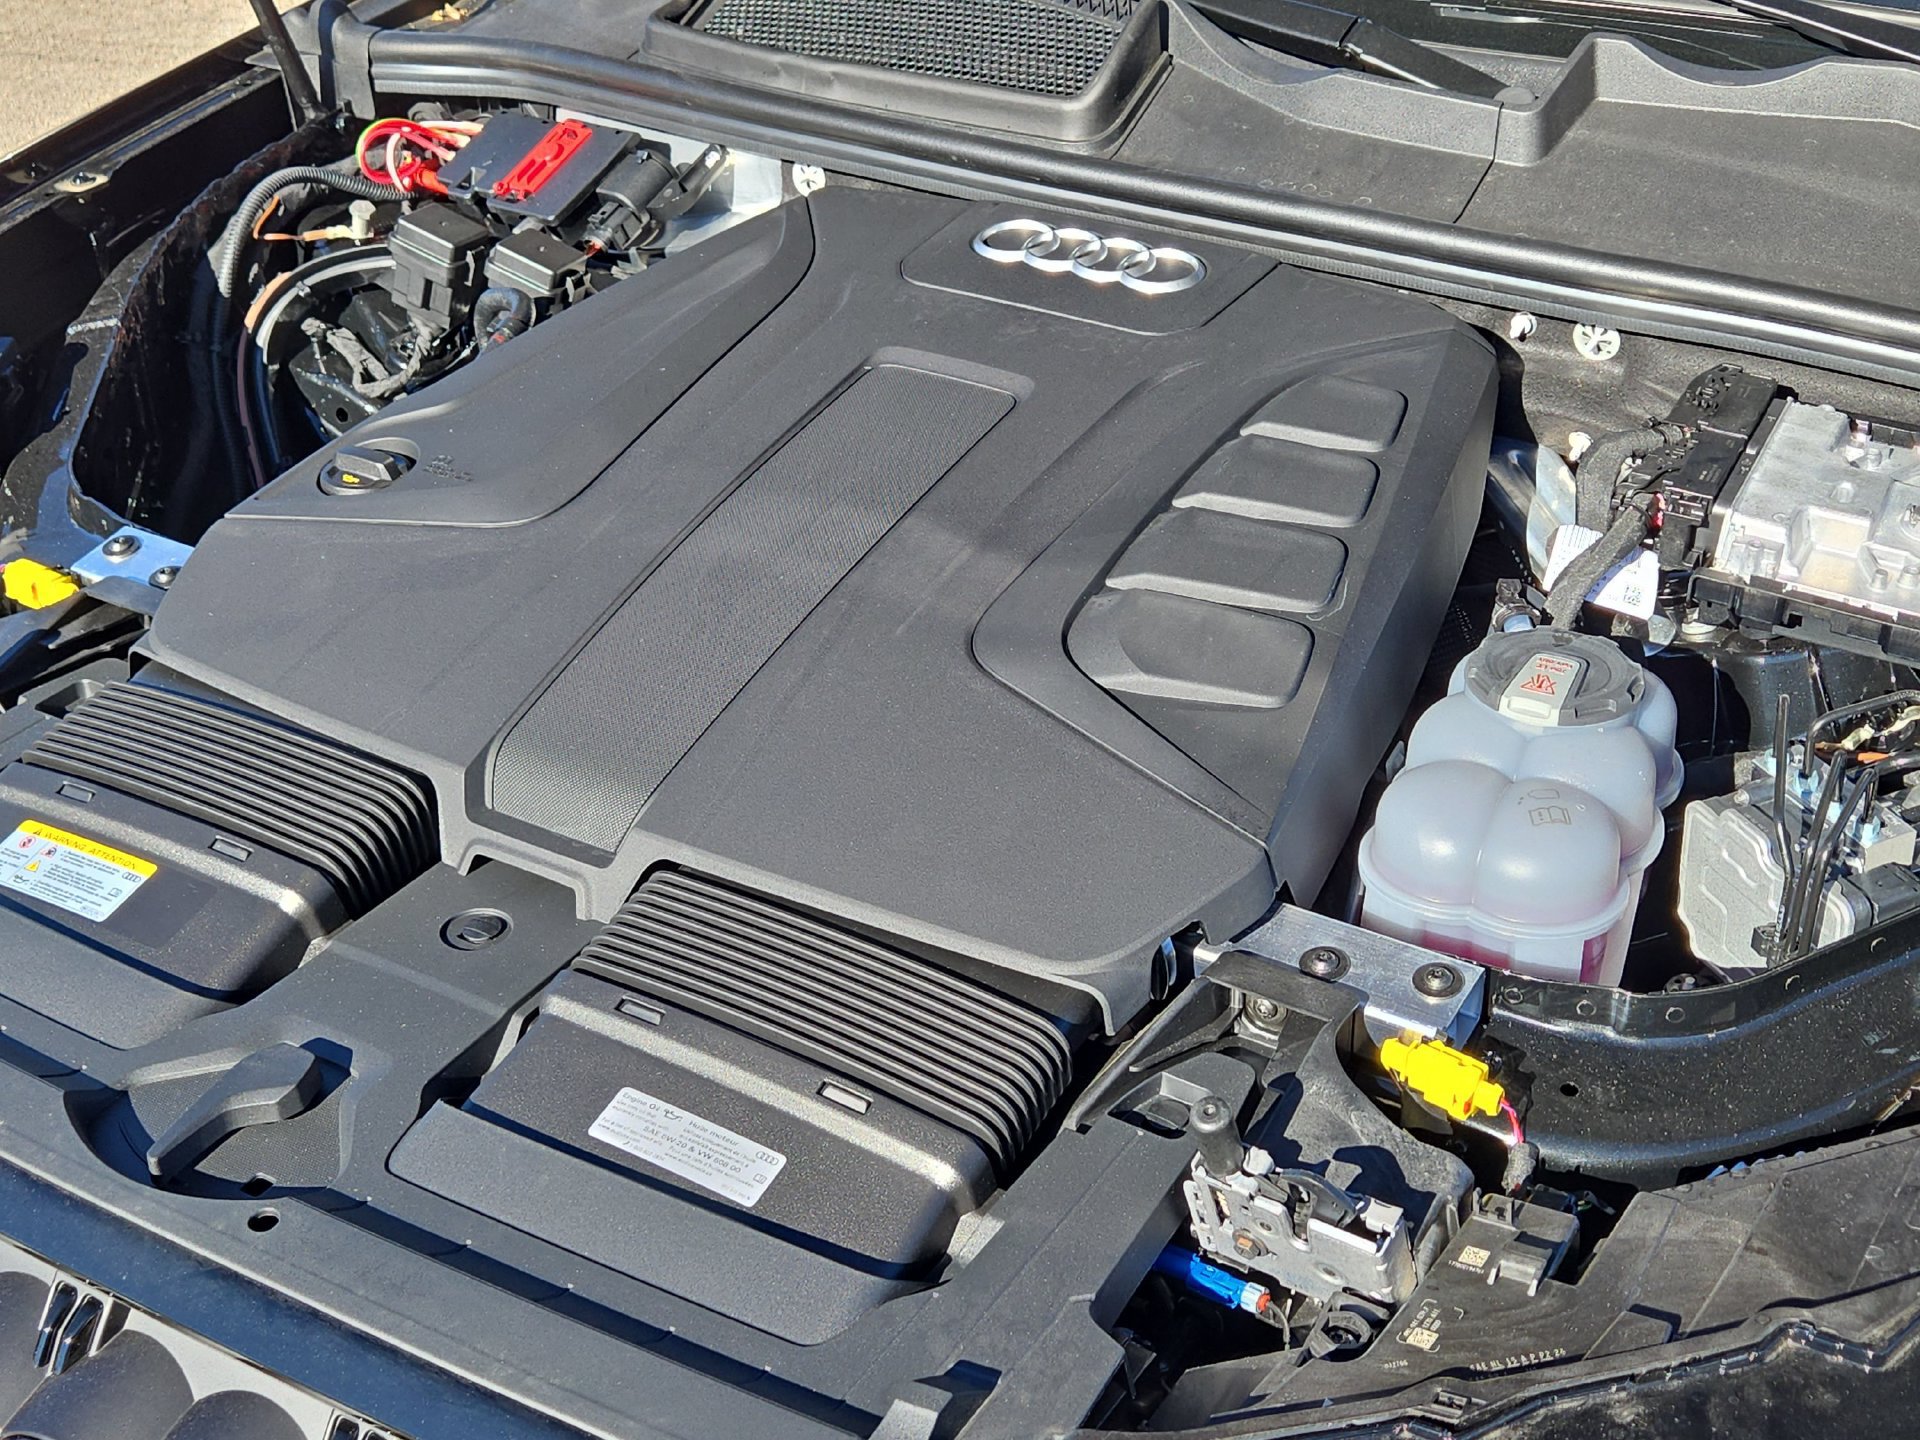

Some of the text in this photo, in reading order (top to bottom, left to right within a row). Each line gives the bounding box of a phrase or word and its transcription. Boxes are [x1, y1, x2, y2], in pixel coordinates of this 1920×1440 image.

[88, 847, 136, 870] ATTENTION
[622, 1091, 647, 1106] Engine
[709, 1130, 739, 1147] moteur
[698, 1149, 712, 1160] VW
